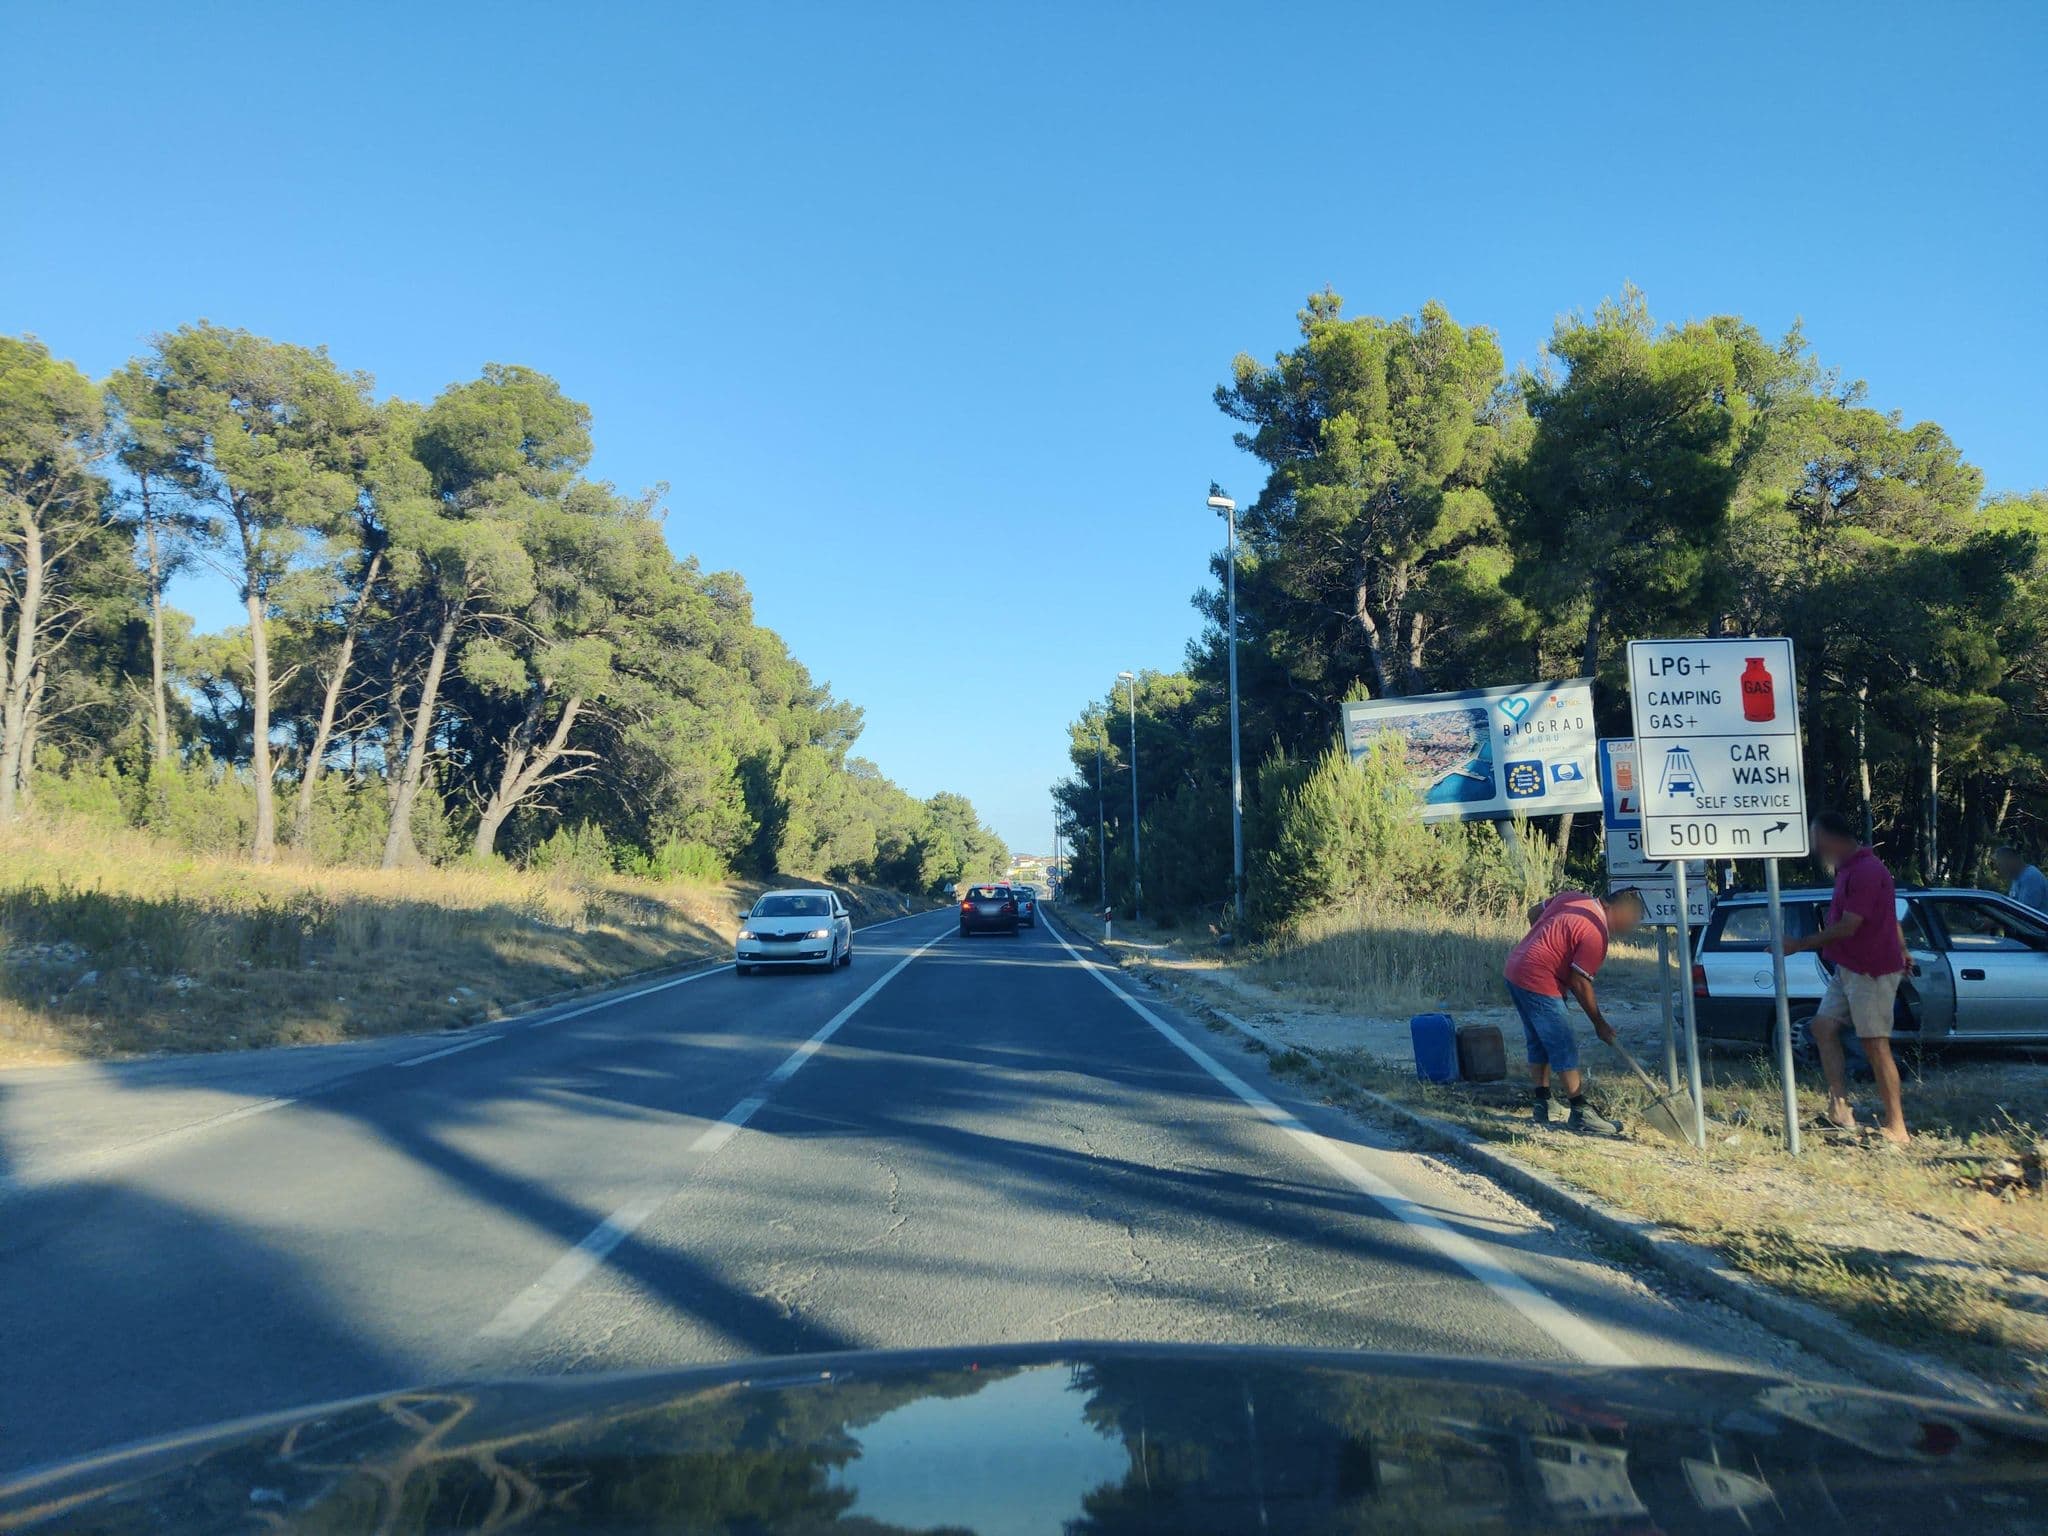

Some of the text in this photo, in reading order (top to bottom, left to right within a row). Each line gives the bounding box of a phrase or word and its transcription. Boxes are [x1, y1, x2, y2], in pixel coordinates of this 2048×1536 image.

[1649, 656, 1711, 677] LPG+
[1743, 680, 1772, 695] GAS
[1648, 690, 1722, 706] CAMPING
[1503, 717, 1584, 737] BIOGRAD
[1650, 713, 1698, 729] GAS+
[1730, 744, 1770, 762] CAR
[1732, 767, 1790, 784] WASH
[1696, 795, 1791, 809] SELF SERVICE
[1670, 823, 1750, 846] 500 m
